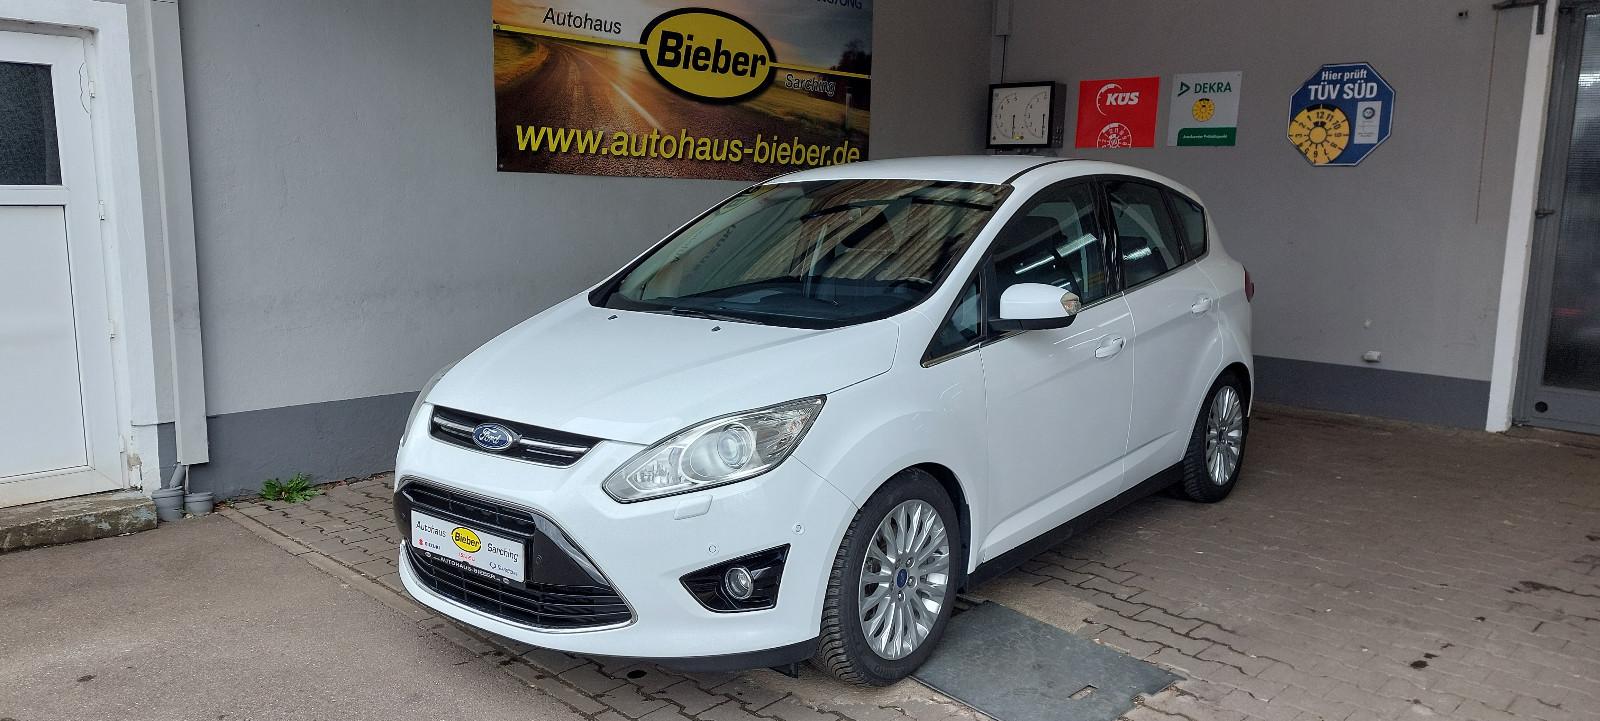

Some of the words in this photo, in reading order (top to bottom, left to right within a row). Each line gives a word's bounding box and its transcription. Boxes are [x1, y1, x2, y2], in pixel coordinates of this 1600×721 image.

[543, 7, 623, 34] Autohaus
[656, 30, 767, 78] Bieber
[785, 74, 837, 96] Sarching
[1321, 71, 1344, 81] Hier
[1344, 68, 1368, 82] prüft
[1105, 91, 1140, 106] KÜS
[1194, 81, 1232, 94] DEKRA
[1308, 81, 1341, 101] TÜV
[1342, 79, 1378, 100] SÜD
[1316, 111, 1325, 119] 12
[515, 124, 860, 167] www.autohaus-bieber.de
[478, 427, 502, 444] Ford
[415, 520, 447, 538] Autohaus
[454, 531, 480, 547] Bieber
[487, 542, 519, 563] Sarching
